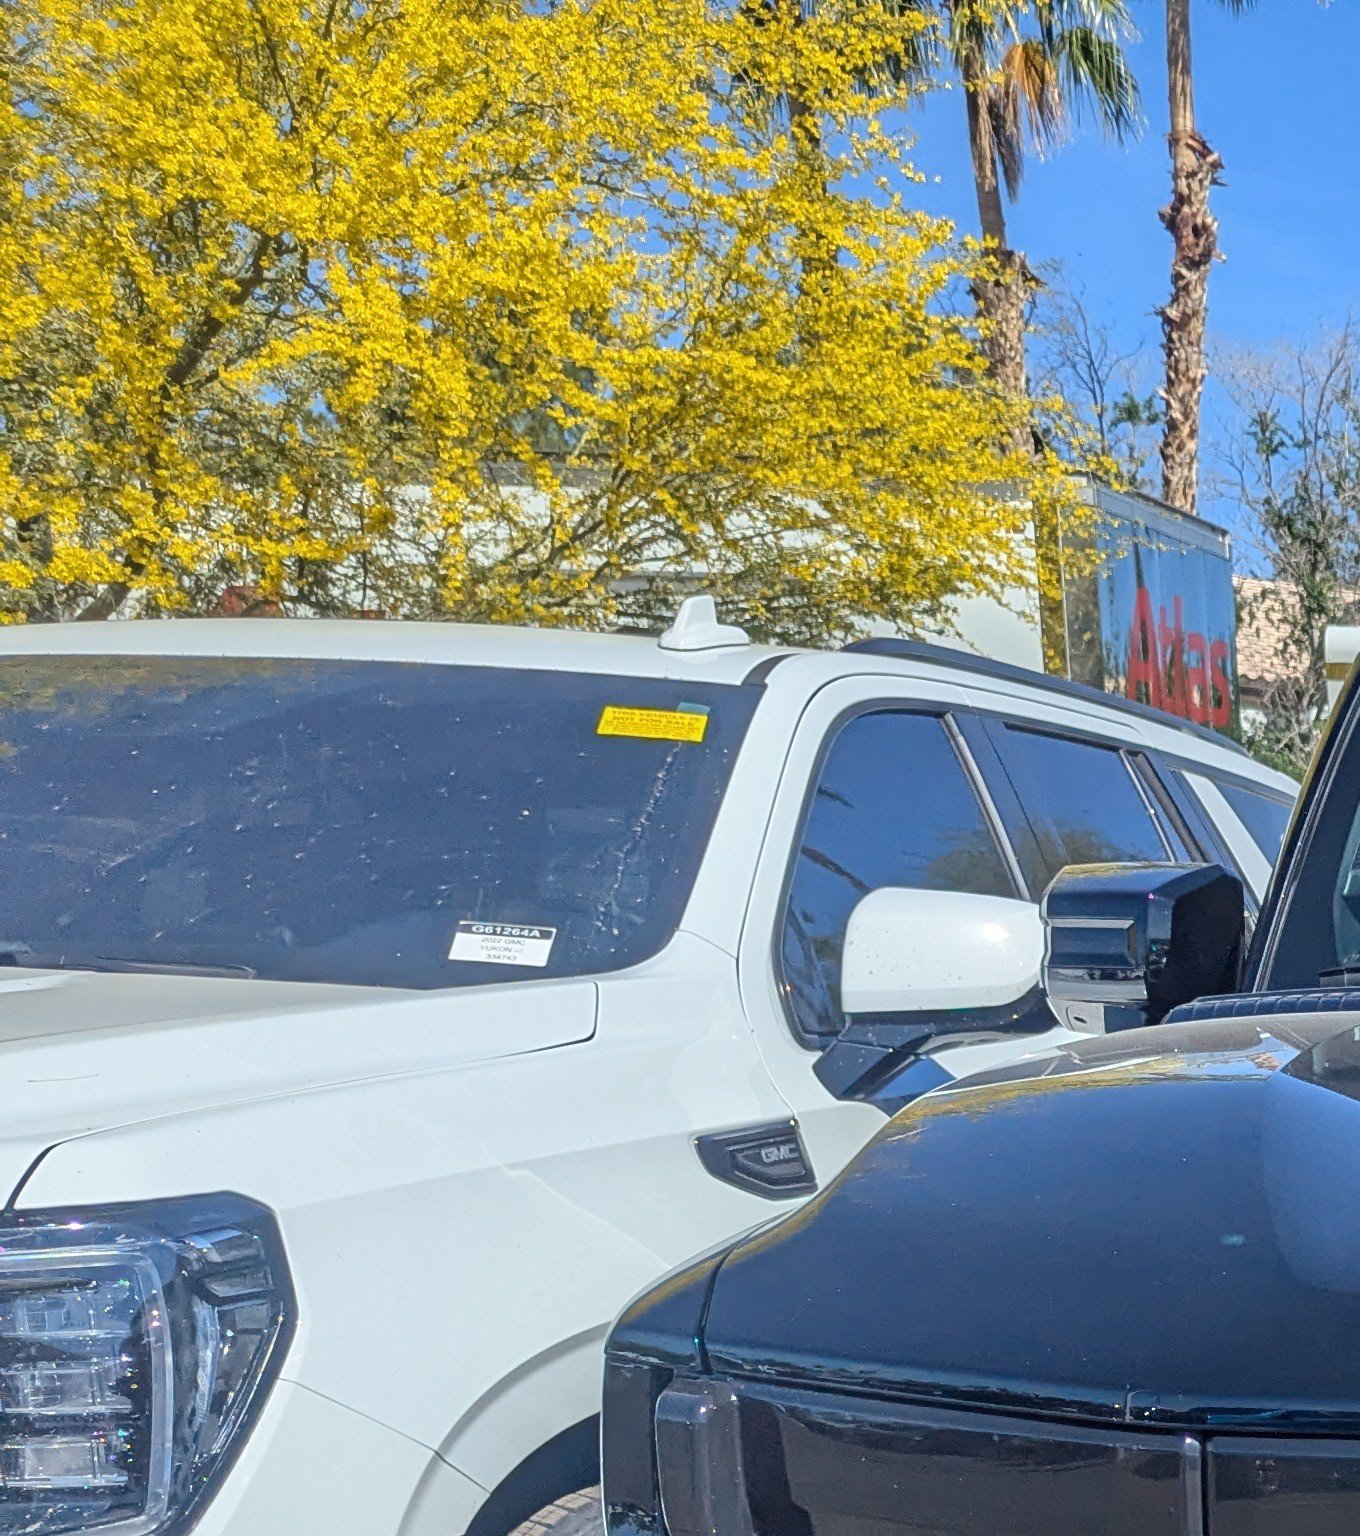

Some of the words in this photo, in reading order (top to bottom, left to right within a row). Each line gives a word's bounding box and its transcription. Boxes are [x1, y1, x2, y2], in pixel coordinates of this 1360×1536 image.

[1126, 587, 1232, 727] Atlas
[471, 924, 541, 938] G61264A
[761, 1142, 800, 1163] GMC
